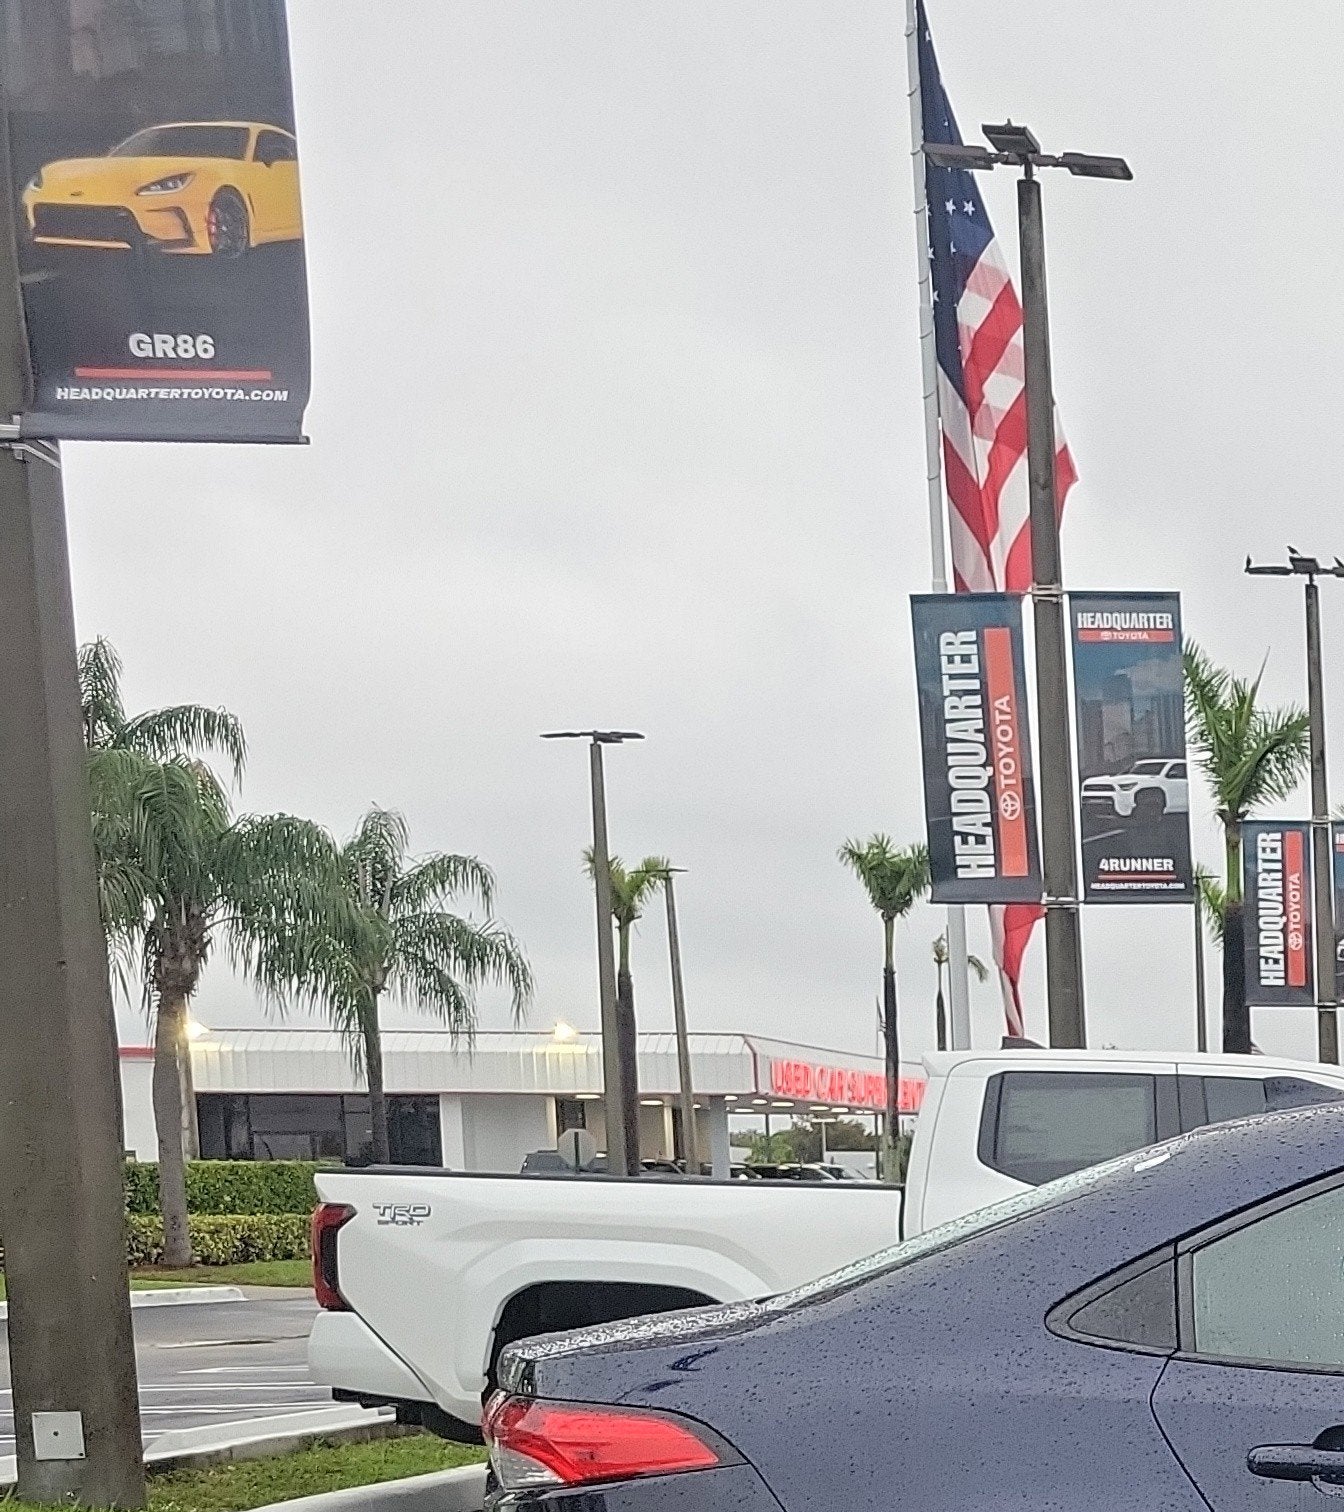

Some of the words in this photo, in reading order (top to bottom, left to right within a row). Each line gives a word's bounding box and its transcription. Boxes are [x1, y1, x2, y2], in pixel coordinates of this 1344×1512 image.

[128, 333, 216, 359] GR86
[56, 387, 289, 402] HEADQUARTERTOYOTA.COM
[1077, 612, 1174, 630] HEADQUARTER
[1113, 631, 1150, 641] TOYOTA
[940, 630, 996, 879] HEADQUARTER
[994, 695, 1019, 789] TOYOTA
[1098, 858, 1175, 872] 4RUNNER
[1257, 831, 1287, 987] HEADQUARTER
[1288, 872, 1302, 928] TOYOTA
[771, 1060, 813, 1097] USED
[816, 1066, 847, 1102] CAR
[372, 1203, 432, 1220] TRD
